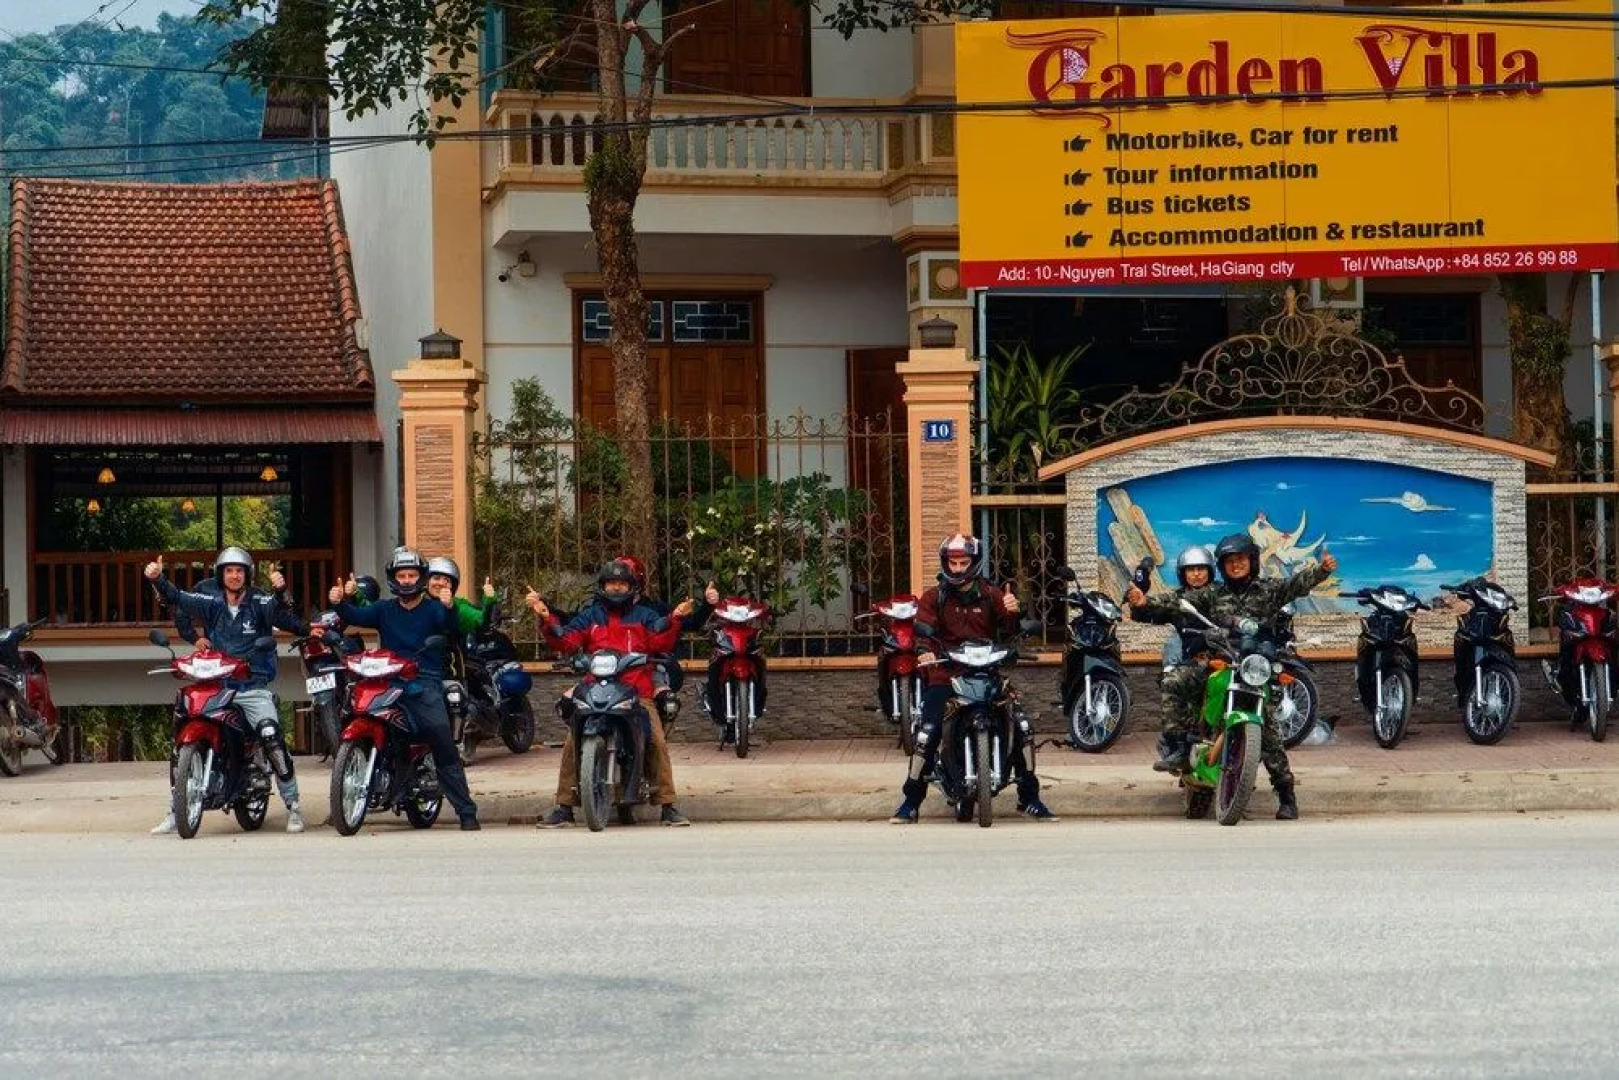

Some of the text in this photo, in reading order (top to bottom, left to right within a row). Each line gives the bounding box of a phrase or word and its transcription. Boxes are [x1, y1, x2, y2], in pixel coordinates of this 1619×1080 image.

[1006, 25, 1543, 128] Garden Villa
[1106, 124, 1398, 151] Motorbike, Car for rent
[1103, 160, 1318, 185] Tour information
[1107, 193, 1251, 215] Bus tickets
[1109, 218, 1485, 247] Accommodation & restaurant
[1483, 252, 1510, 268] 852
[1515, 251, 1534, 266] 26
[1537, 250, 1556, 265] 99
[1559, 250, 1578, 265] 88
[998, 265, 1031, 281] Add:
[1151, 262, 1198, 278] Street,
[930, 423, 950, 438] 10
